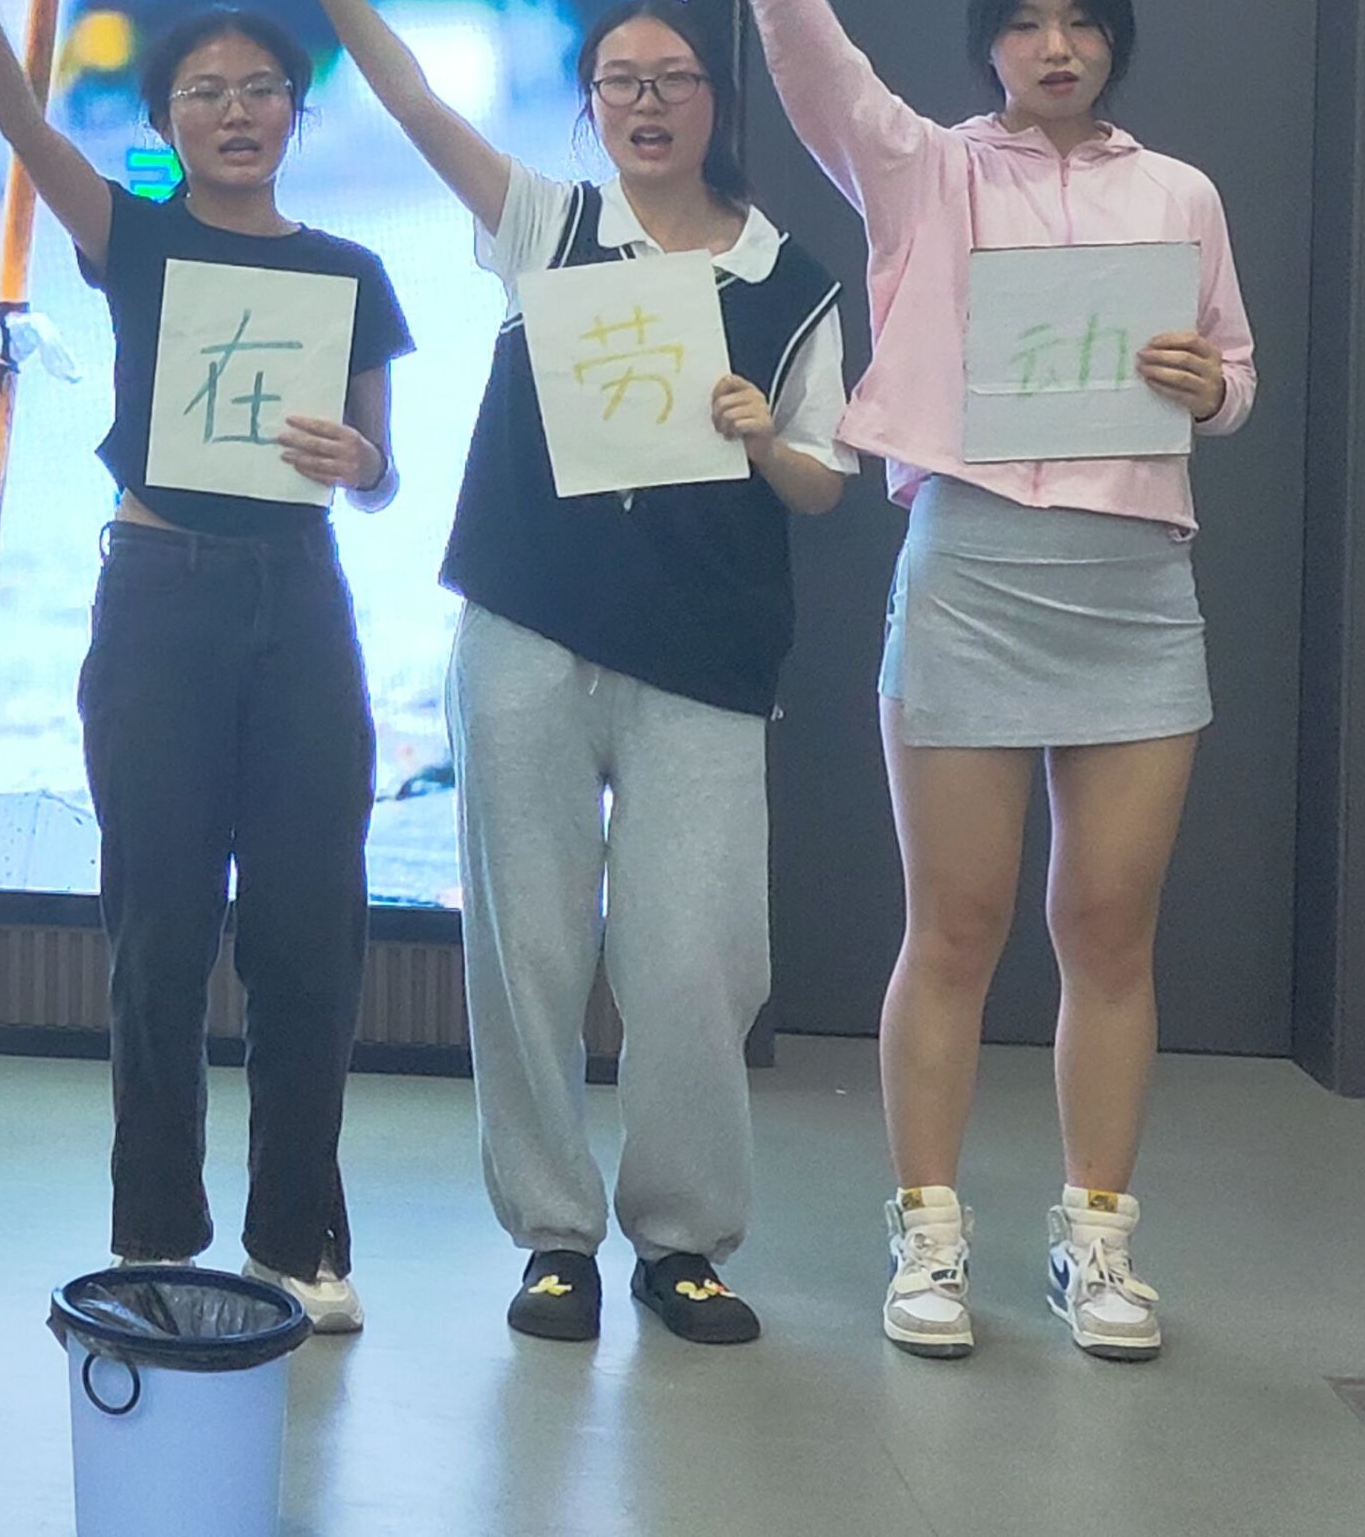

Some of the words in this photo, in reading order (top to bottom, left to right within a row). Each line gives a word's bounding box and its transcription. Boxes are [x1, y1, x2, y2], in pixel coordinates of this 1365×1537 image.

[183, 308, 303, 445] 在
[573, 305, 686, 425] 劳
[1009, 312, 1129, 398] 动
